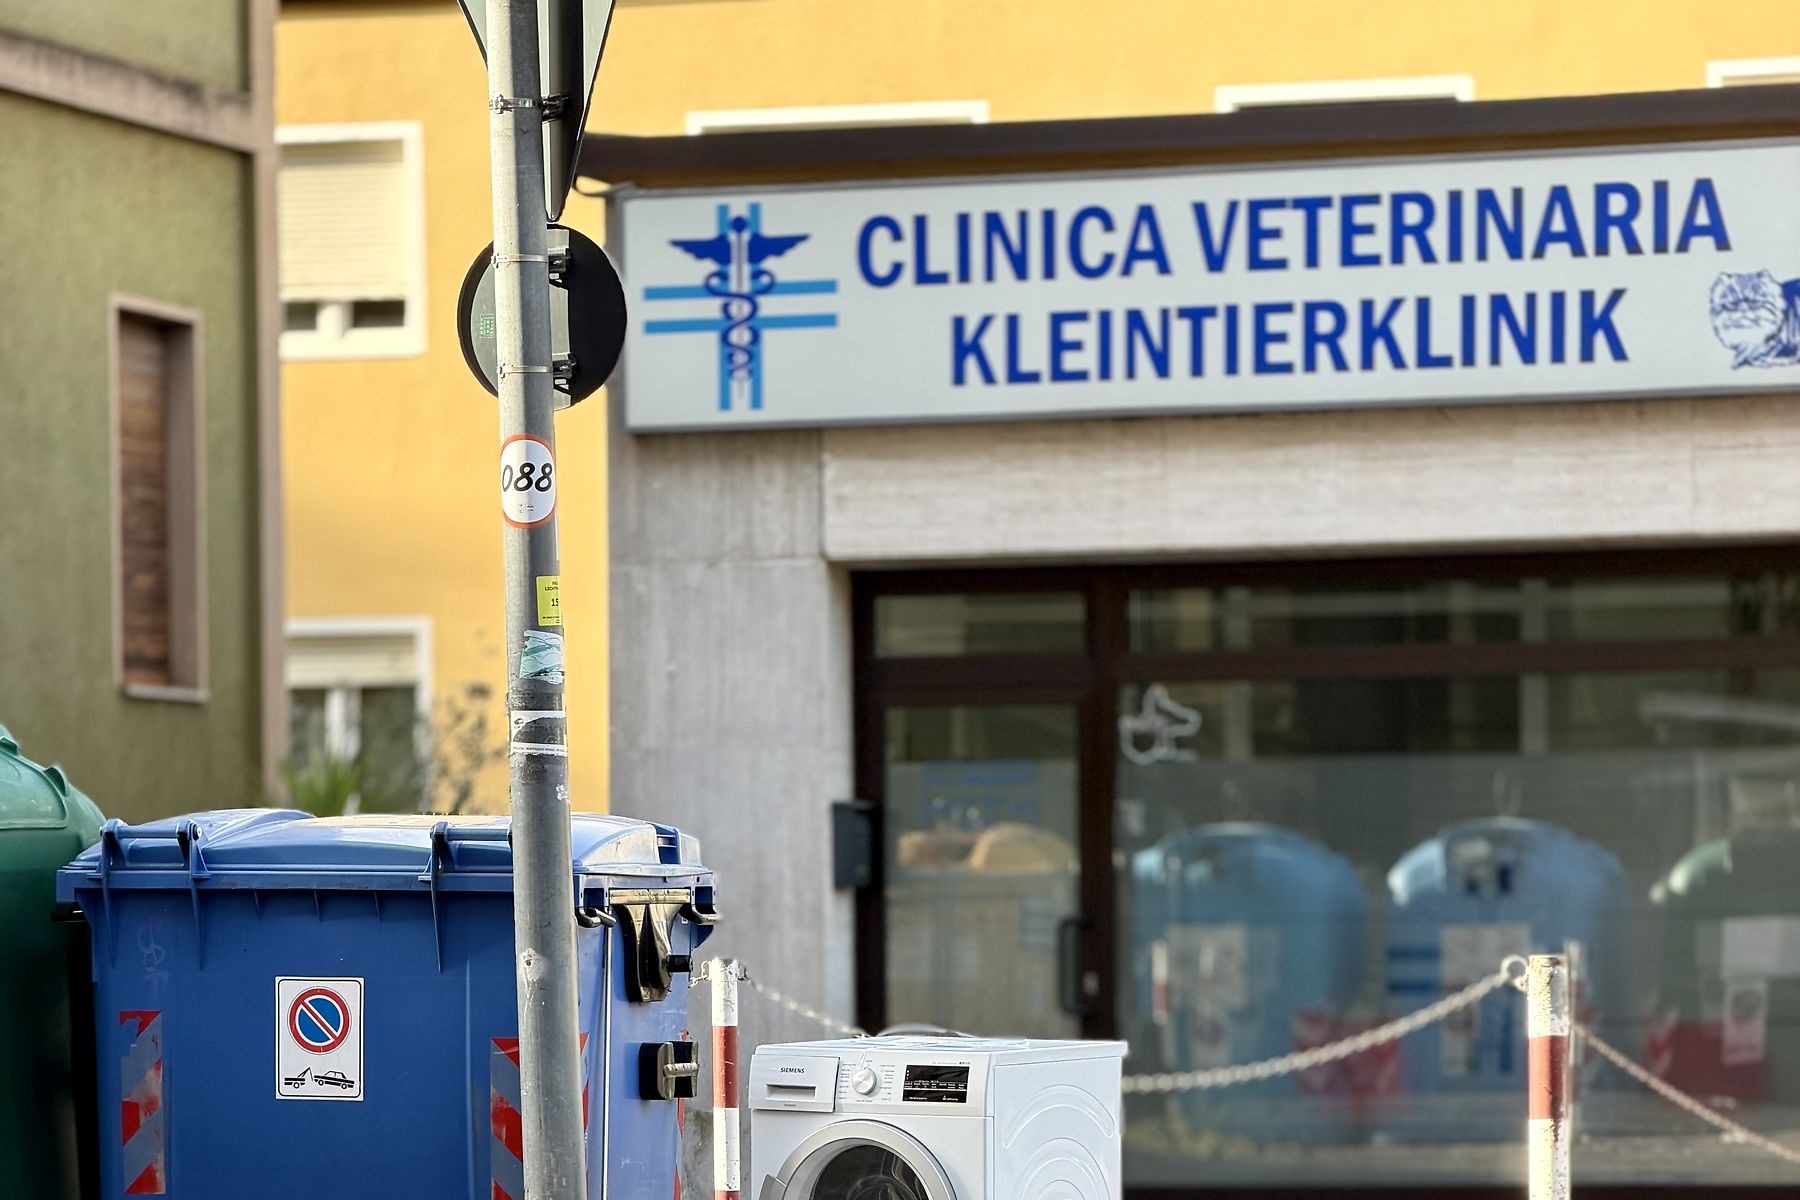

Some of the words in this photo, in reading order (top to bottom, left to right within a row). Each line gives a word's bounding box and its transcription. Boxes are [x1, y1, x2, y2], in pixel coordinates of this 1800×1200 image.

[856, 203, 1172, 288] CLINICA
[1191, 178, 1730, 274] VETERINARIA
[951, 288, 1629, 387] KLEINTIERKLINIK
[502, 462, 553, 493] 088
